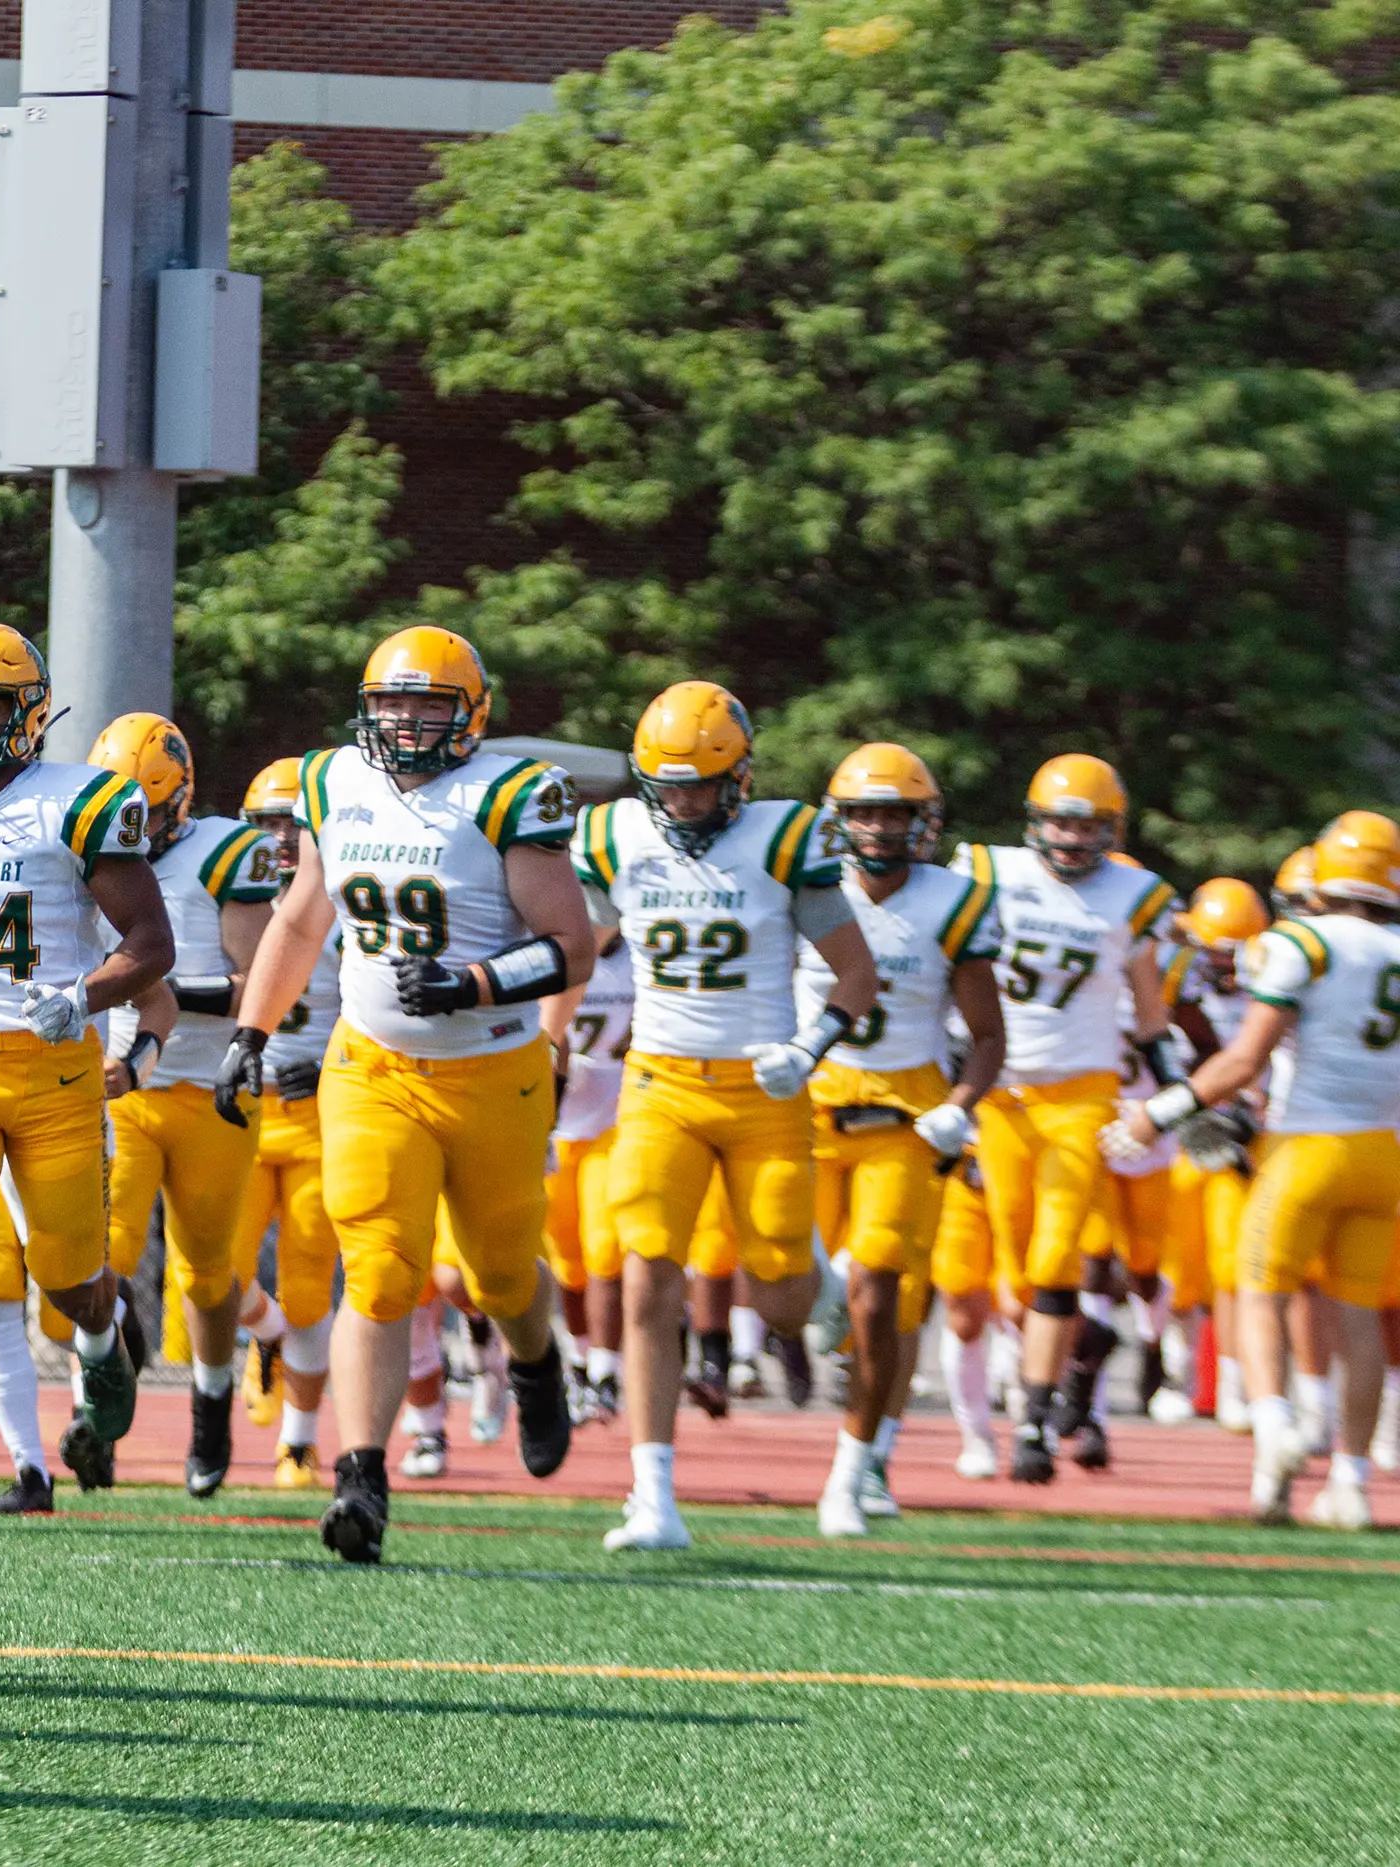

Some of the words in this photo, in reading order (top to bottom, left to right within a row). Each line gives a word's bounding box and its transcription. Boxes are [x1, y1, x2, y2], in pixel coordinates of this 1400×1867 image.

[118, 801, 149, 847] 9
[340, 843, 444, 866] BROCKPORT
[340, 872, 449, 958] 99
[644, 917, 749, 992] 22
[1005, 940, 1098, 1011] 57
